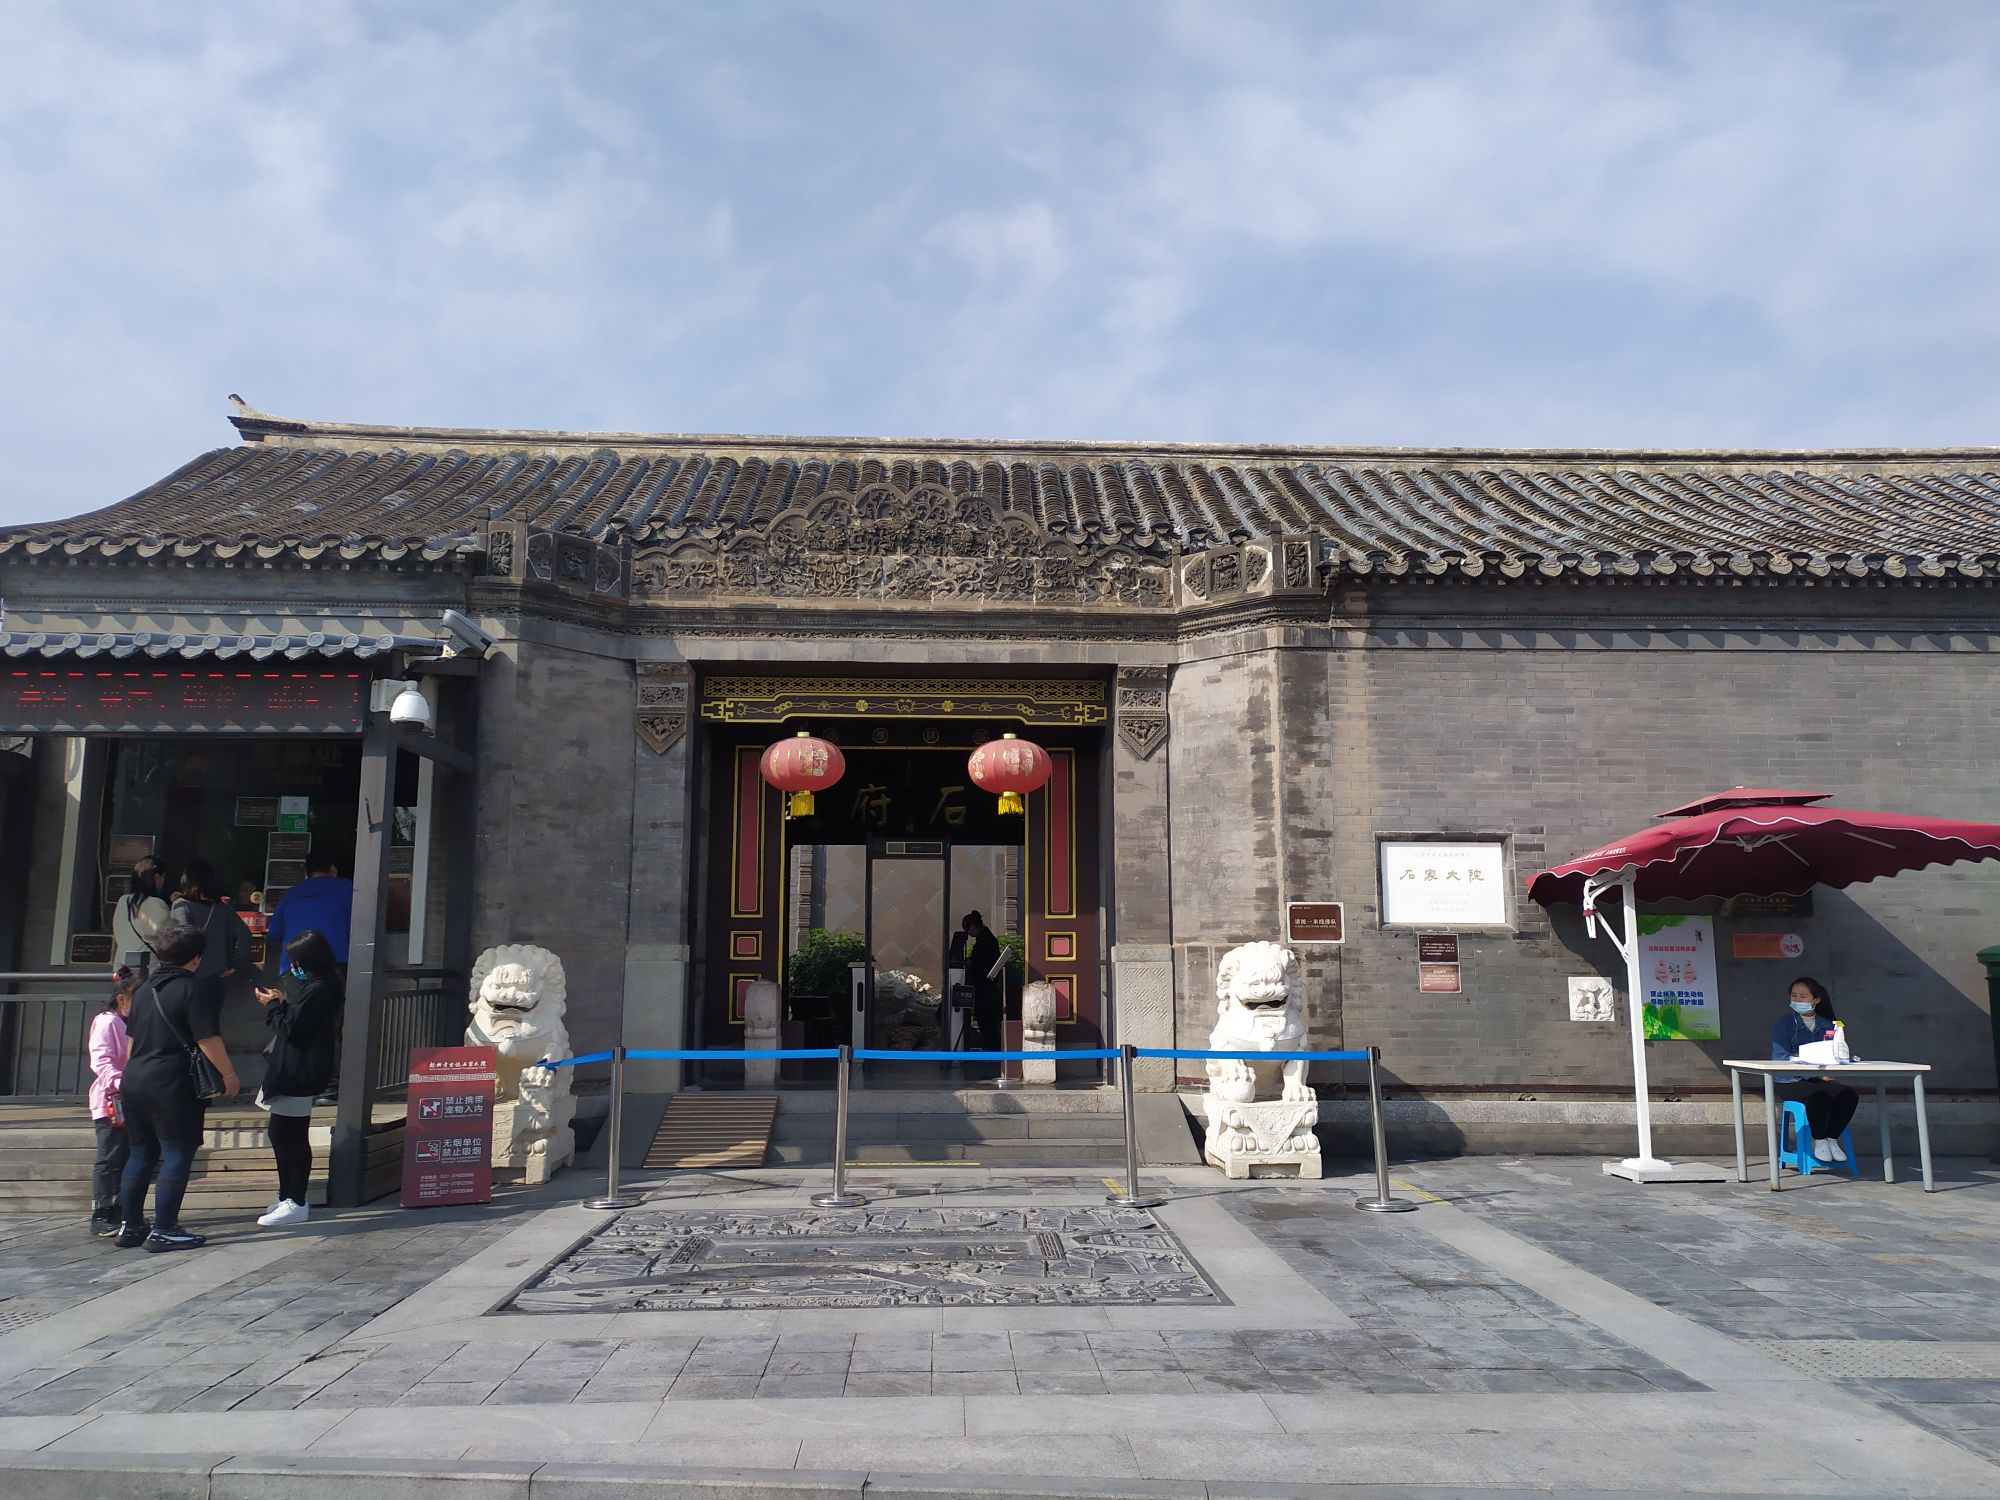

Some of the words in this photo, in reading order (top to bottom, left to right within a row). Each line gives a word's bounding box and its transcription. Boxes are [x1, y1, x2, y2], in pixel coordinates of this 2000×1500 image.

[1399, 868, 1485, 883] 石家大院
[445, 1095, 484, 1105] 禁止携带
[444, 1105, 483, 1114] 宠物入内
[442, 1138, 482, 1147] 无烟单位
[441, 1147, 482, 1157] 禁止吸烟
